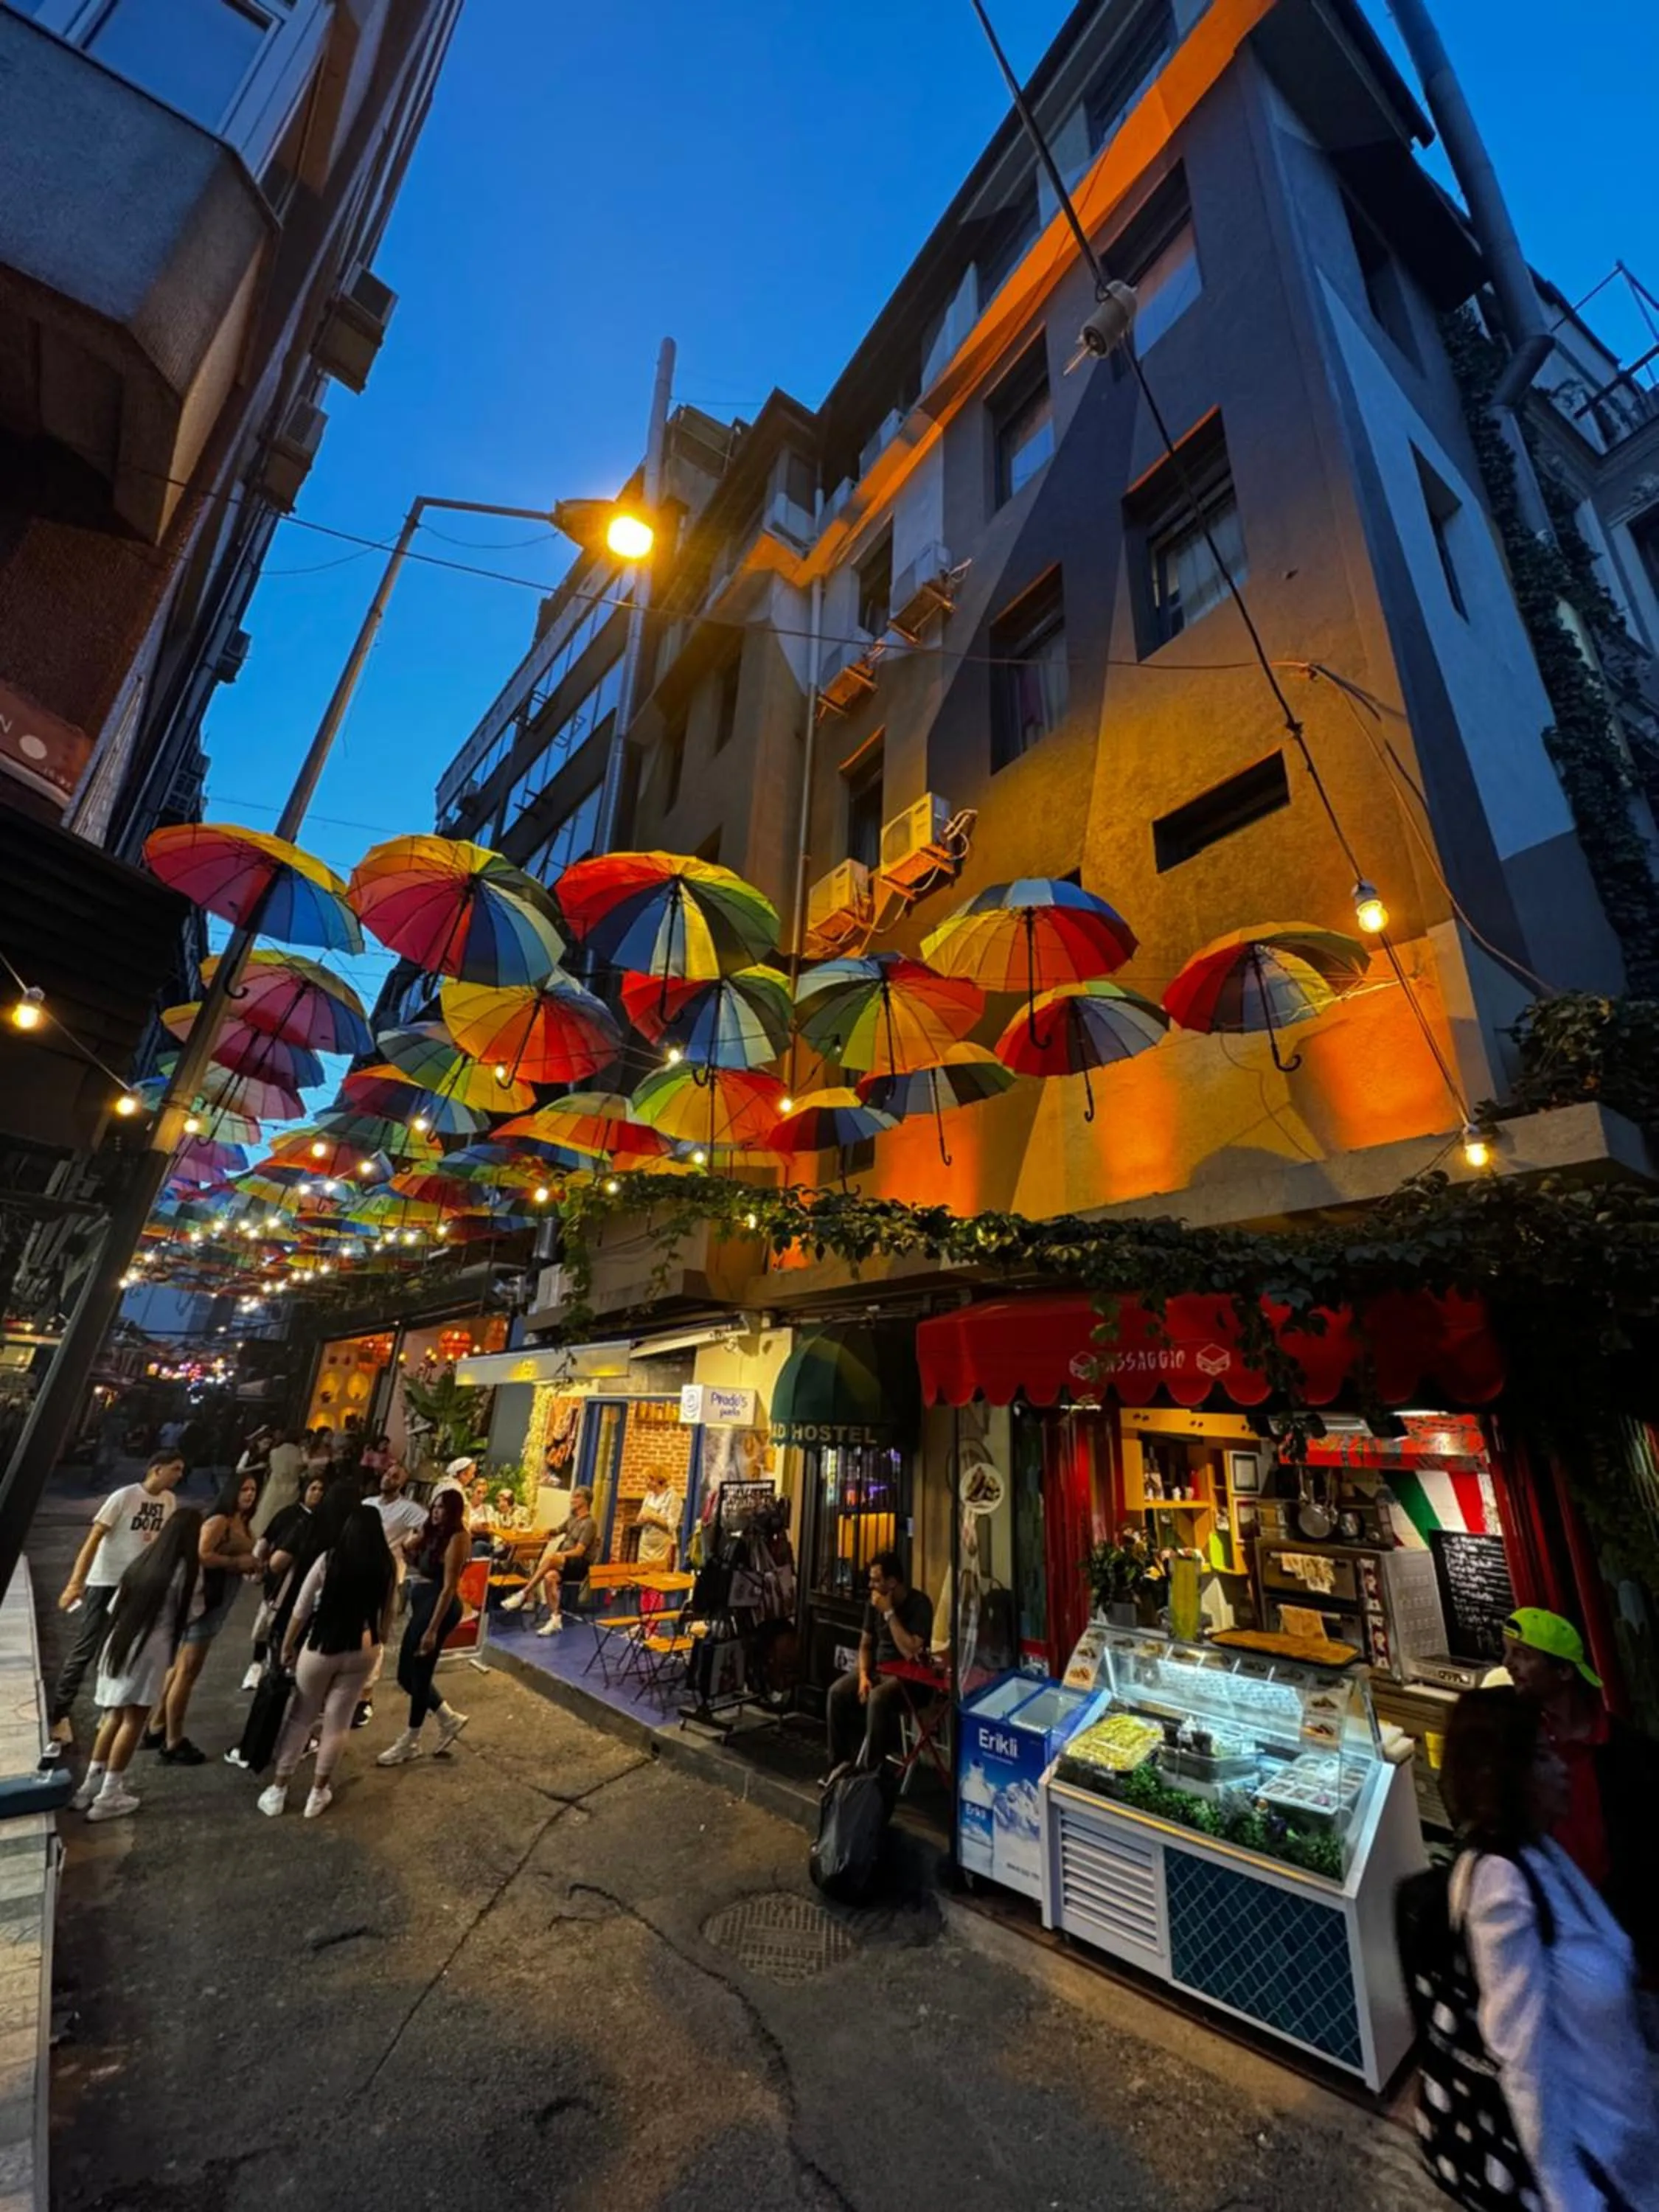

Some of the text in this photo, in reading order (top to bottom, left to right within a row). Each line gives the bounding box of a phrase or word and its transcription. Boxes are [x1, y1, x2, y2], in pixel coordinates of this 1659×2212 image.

[1099, 1349, 1186, 1374] ASSAGGIO
[792, 1422, 877, 1444] HOSTEL
[137, 1501, 164, 1517] JUST
[978, 1727, 1019, 1759] Erikli
